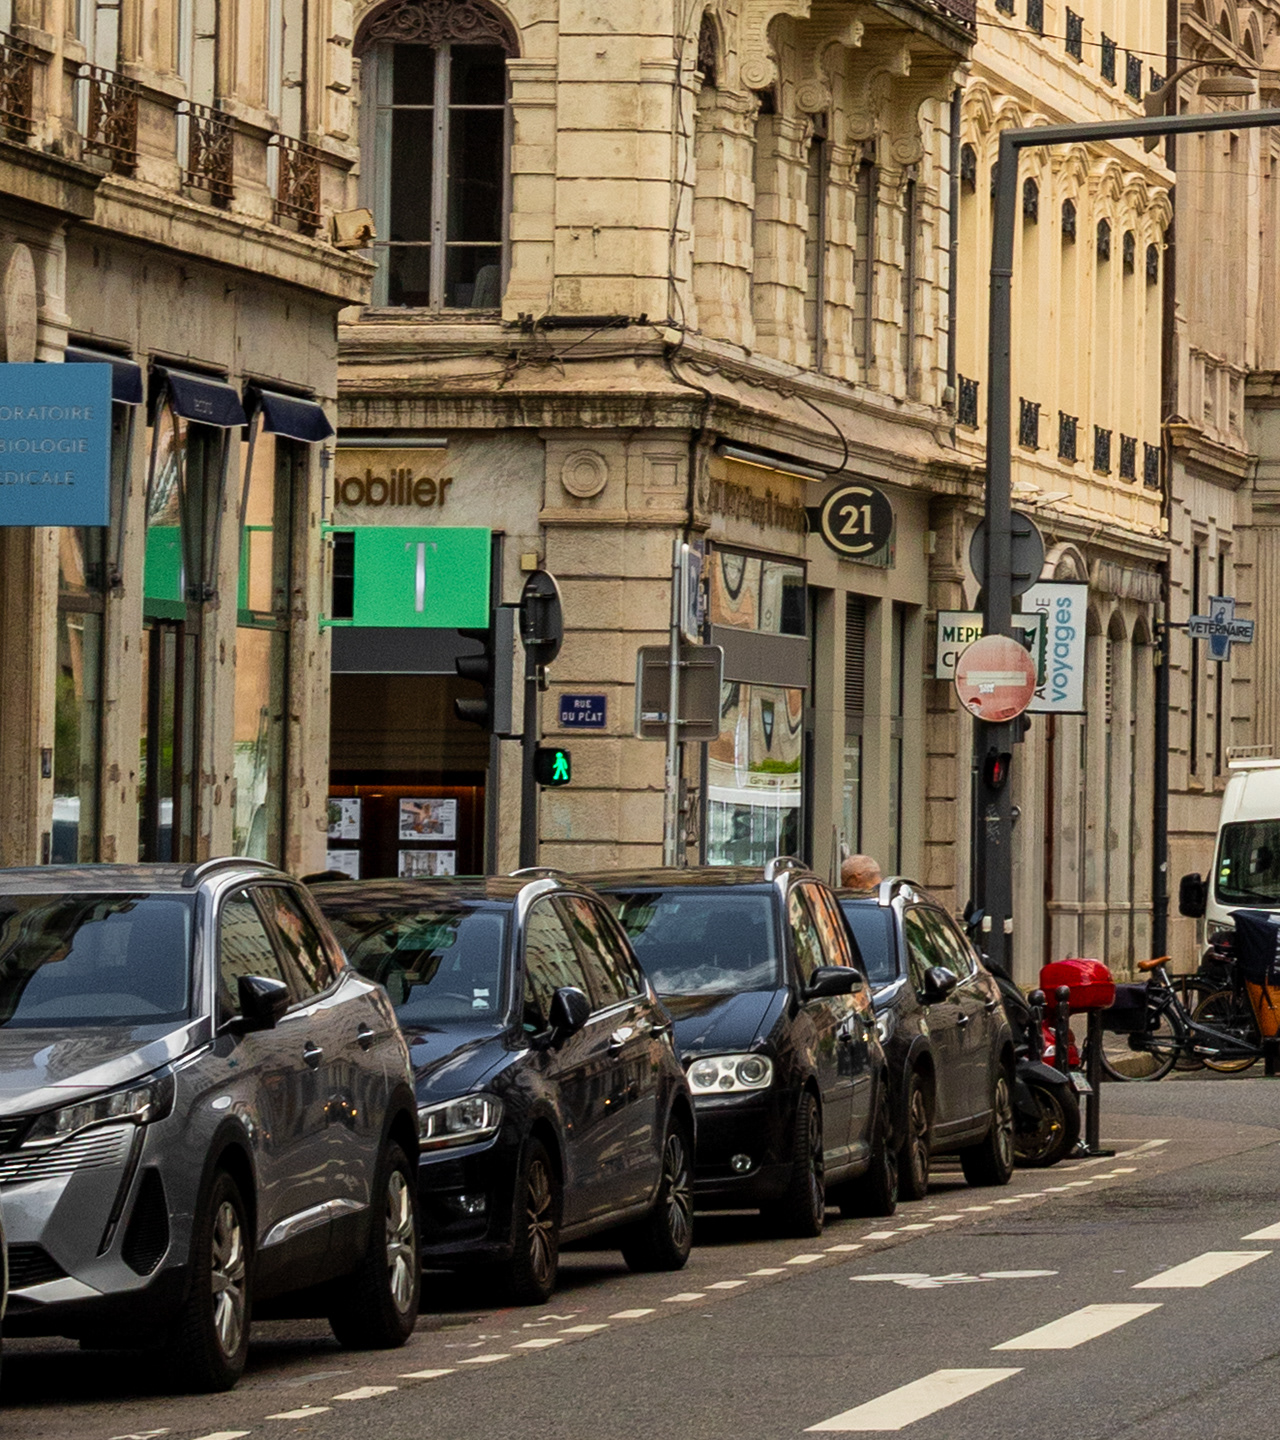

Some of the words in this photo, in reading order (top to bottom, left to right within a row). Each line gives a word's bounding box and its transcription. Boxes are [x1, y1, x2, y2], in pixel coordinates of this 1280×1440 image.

[0, 471, 75, 485] DICALE
[1051, 597, 1076, 703] voyages
[574, 700, 592, 708] RUE
[562, 712, 575, 721] DU
